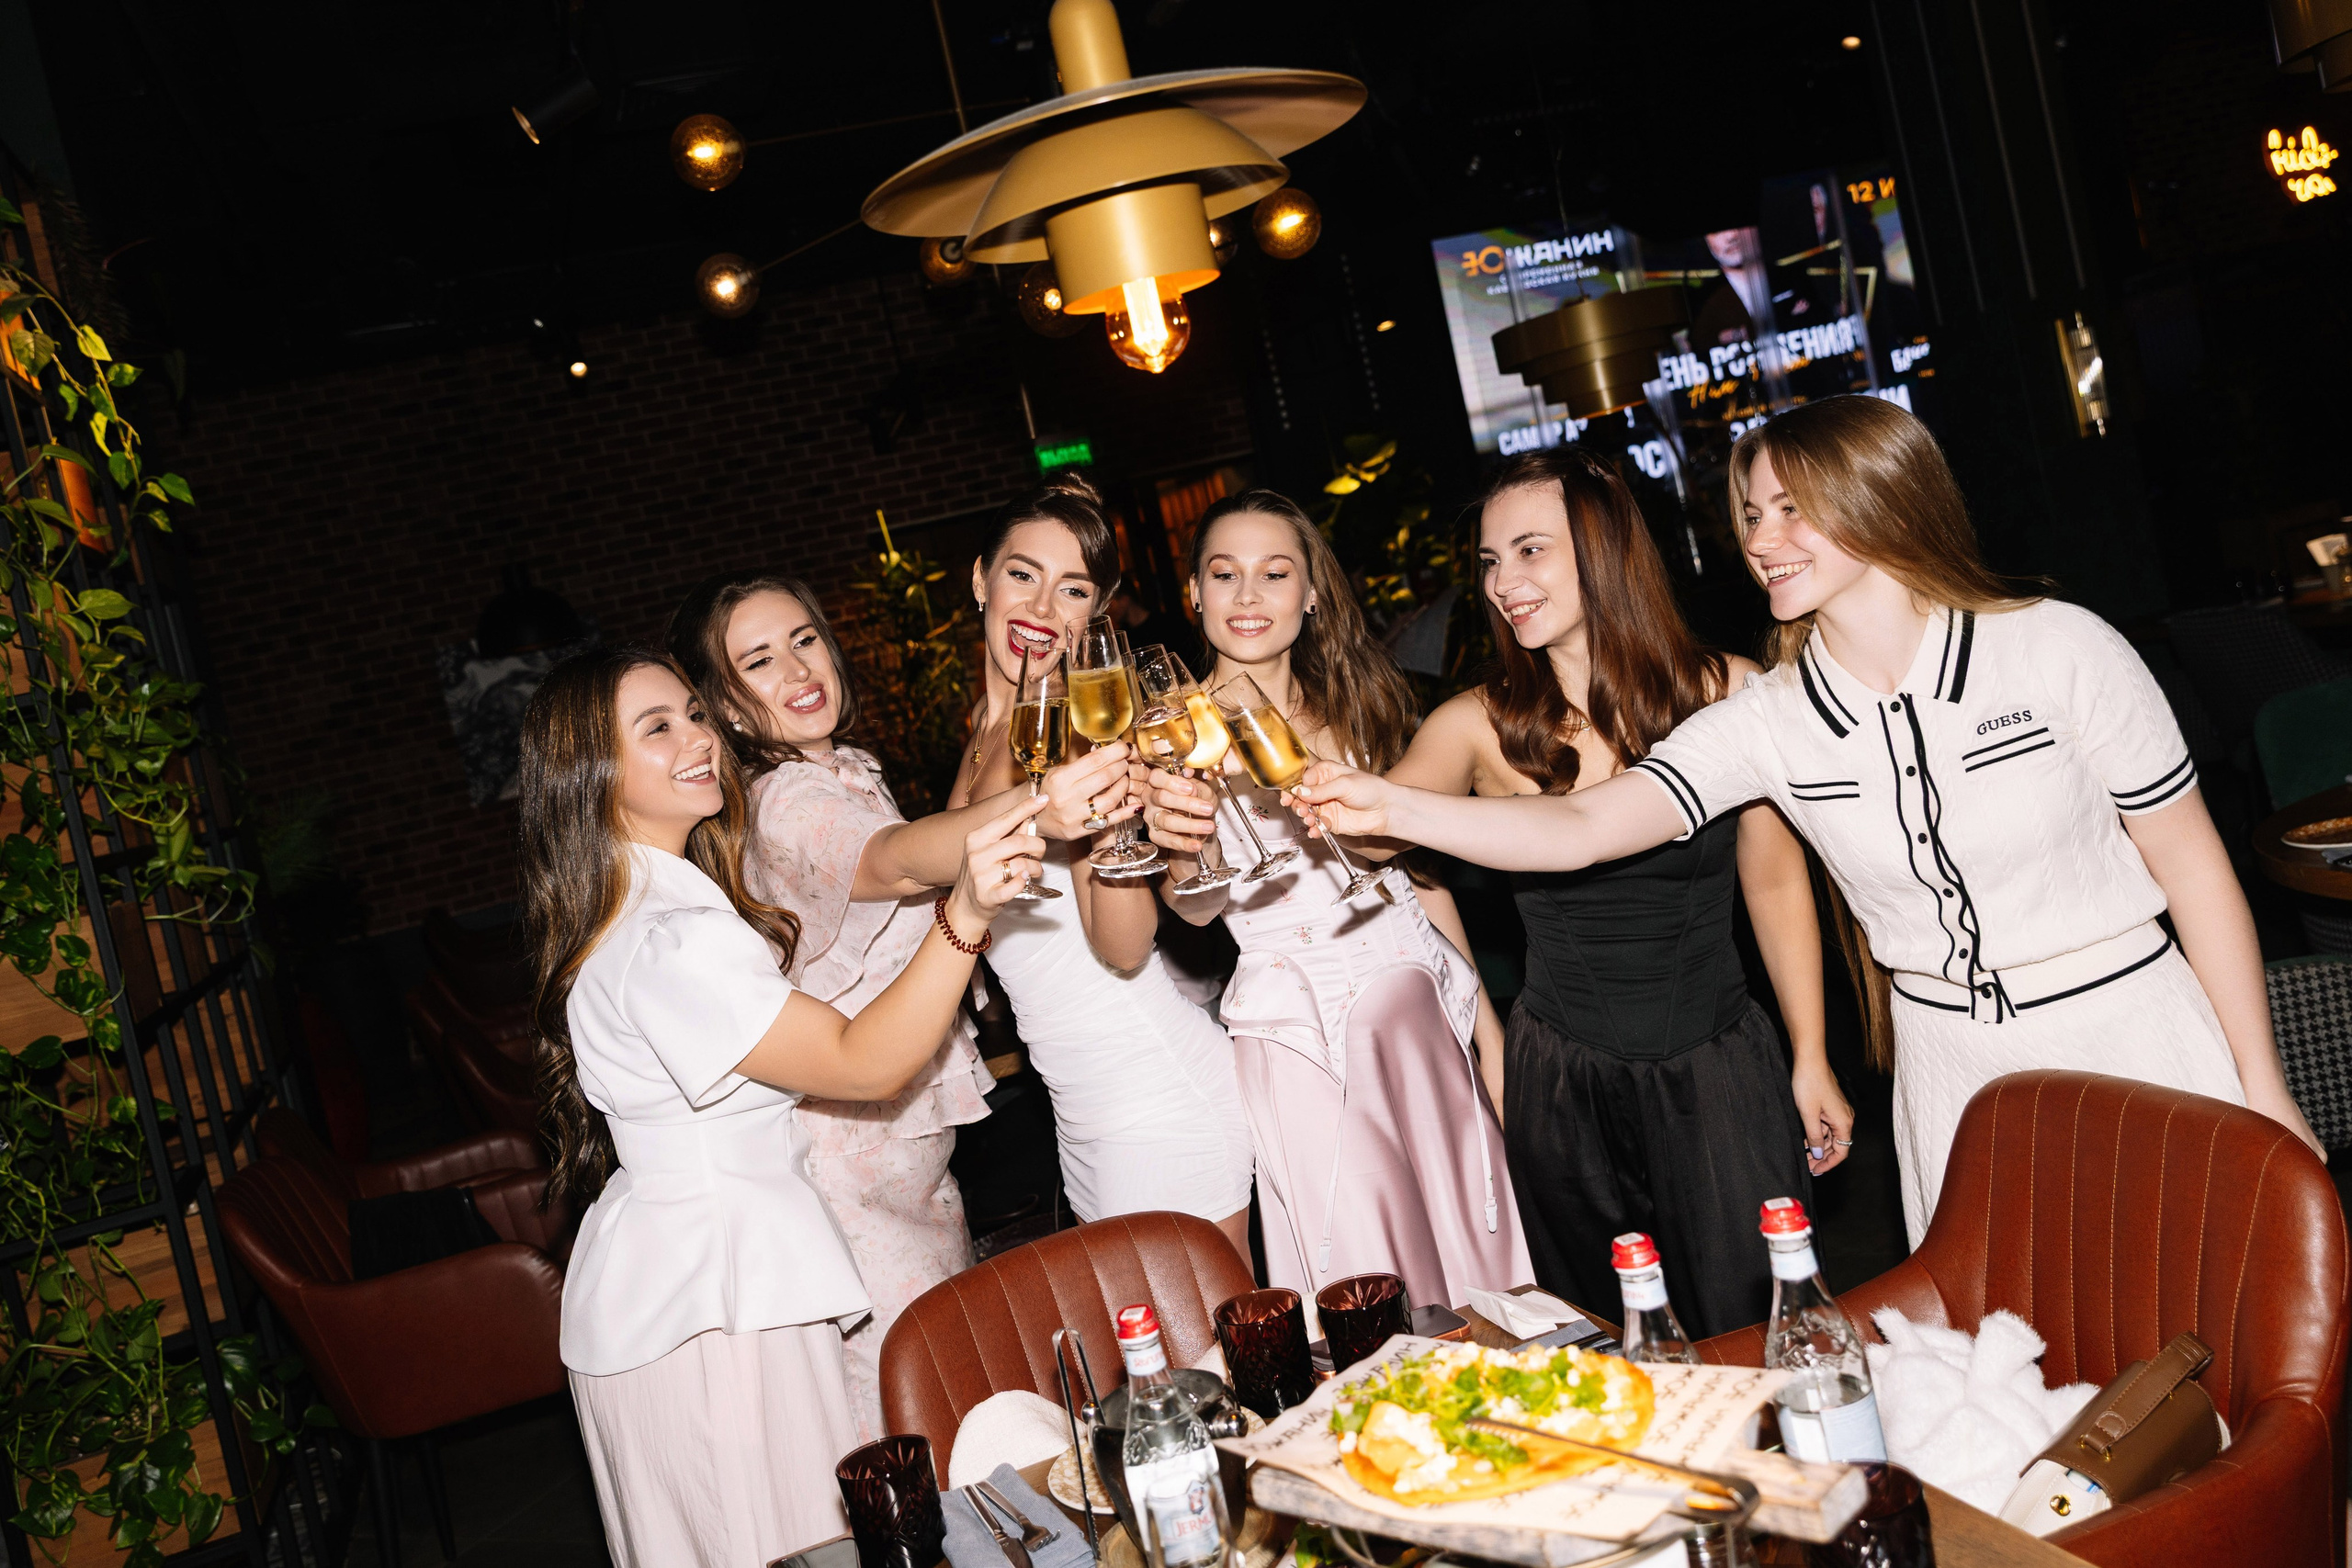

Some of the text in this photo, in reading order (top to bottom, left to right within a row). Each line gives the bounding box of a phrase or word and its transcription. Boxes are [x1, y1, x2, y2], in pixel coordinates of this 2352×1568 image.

[1846, 180, 1876, 205] 12
[1657, 351, 1711, 392] ЕНЬ
[1976, 709, 2033, 736] GUESS
